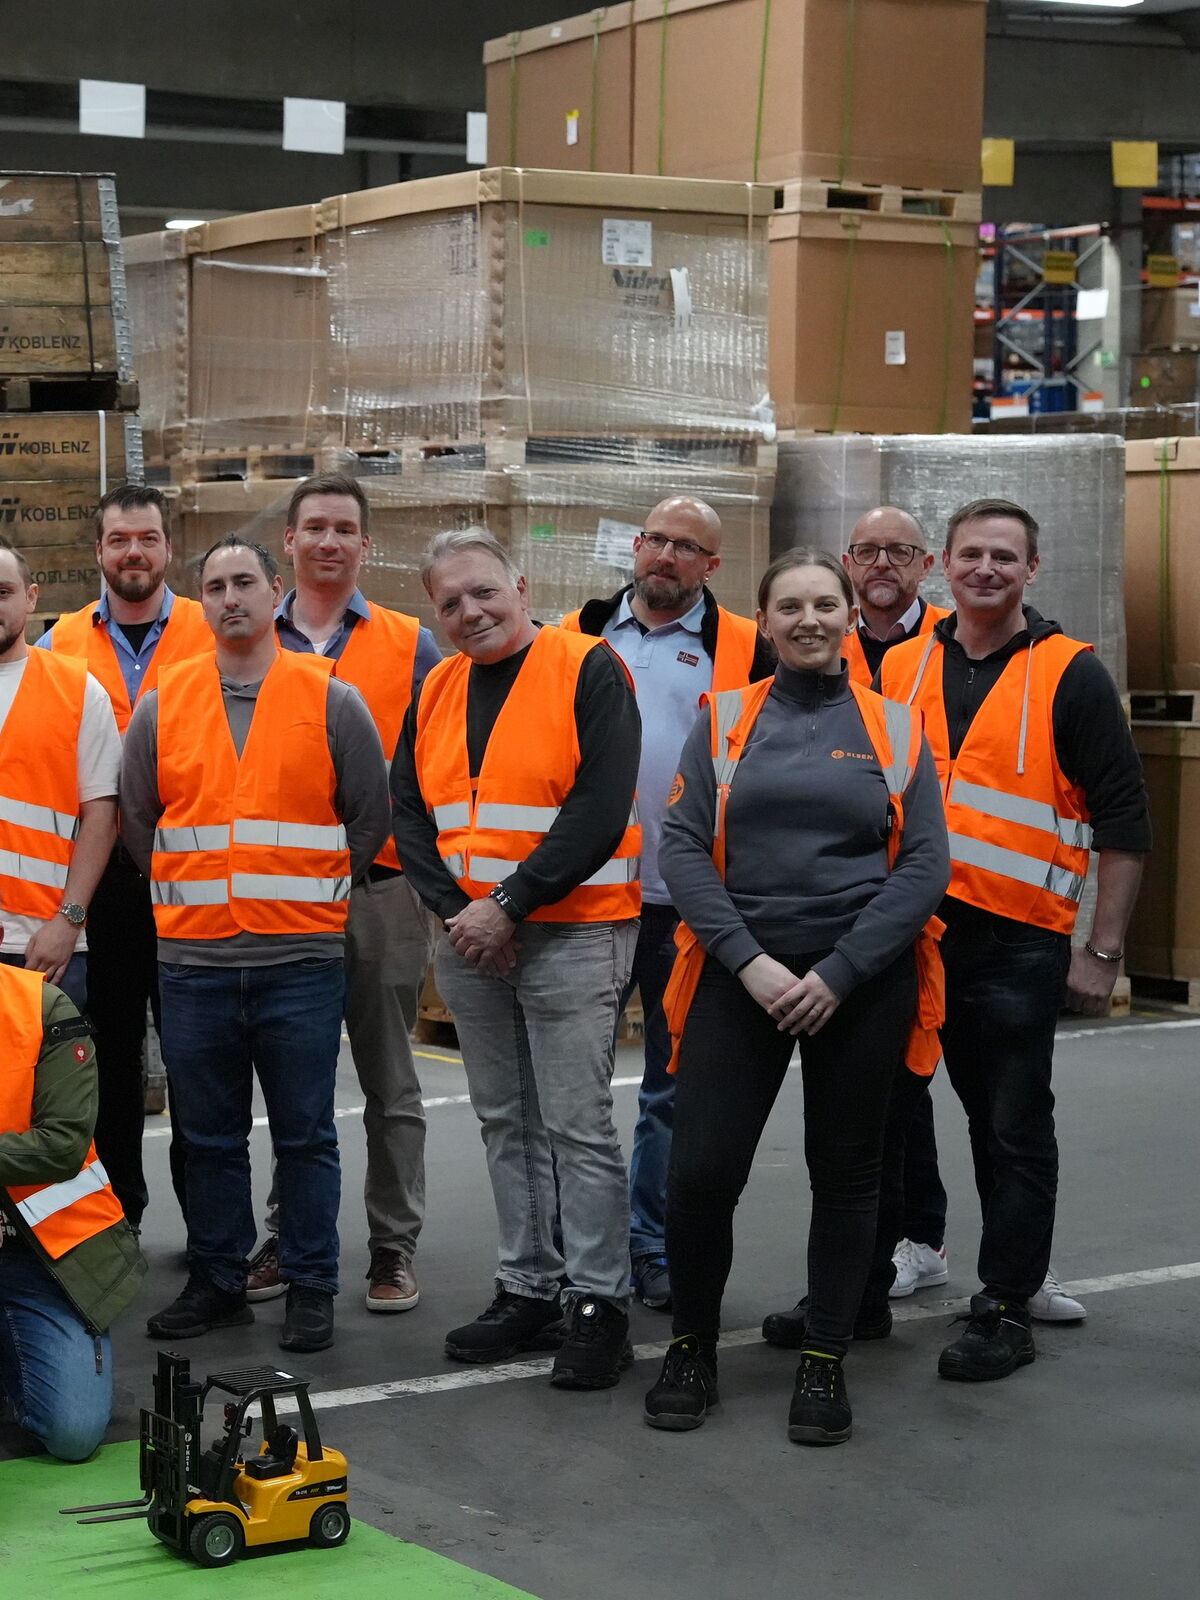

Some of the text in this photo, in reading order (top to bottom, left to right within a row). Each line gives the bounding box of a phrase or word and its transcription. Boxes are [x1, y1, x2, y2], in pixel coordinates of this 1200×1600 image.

[9, 335, 81, 349] KOBLENZ
[19, 440, 91, 455] KOBLENZ
[20, 504, 101, 523] KOBLENZ
